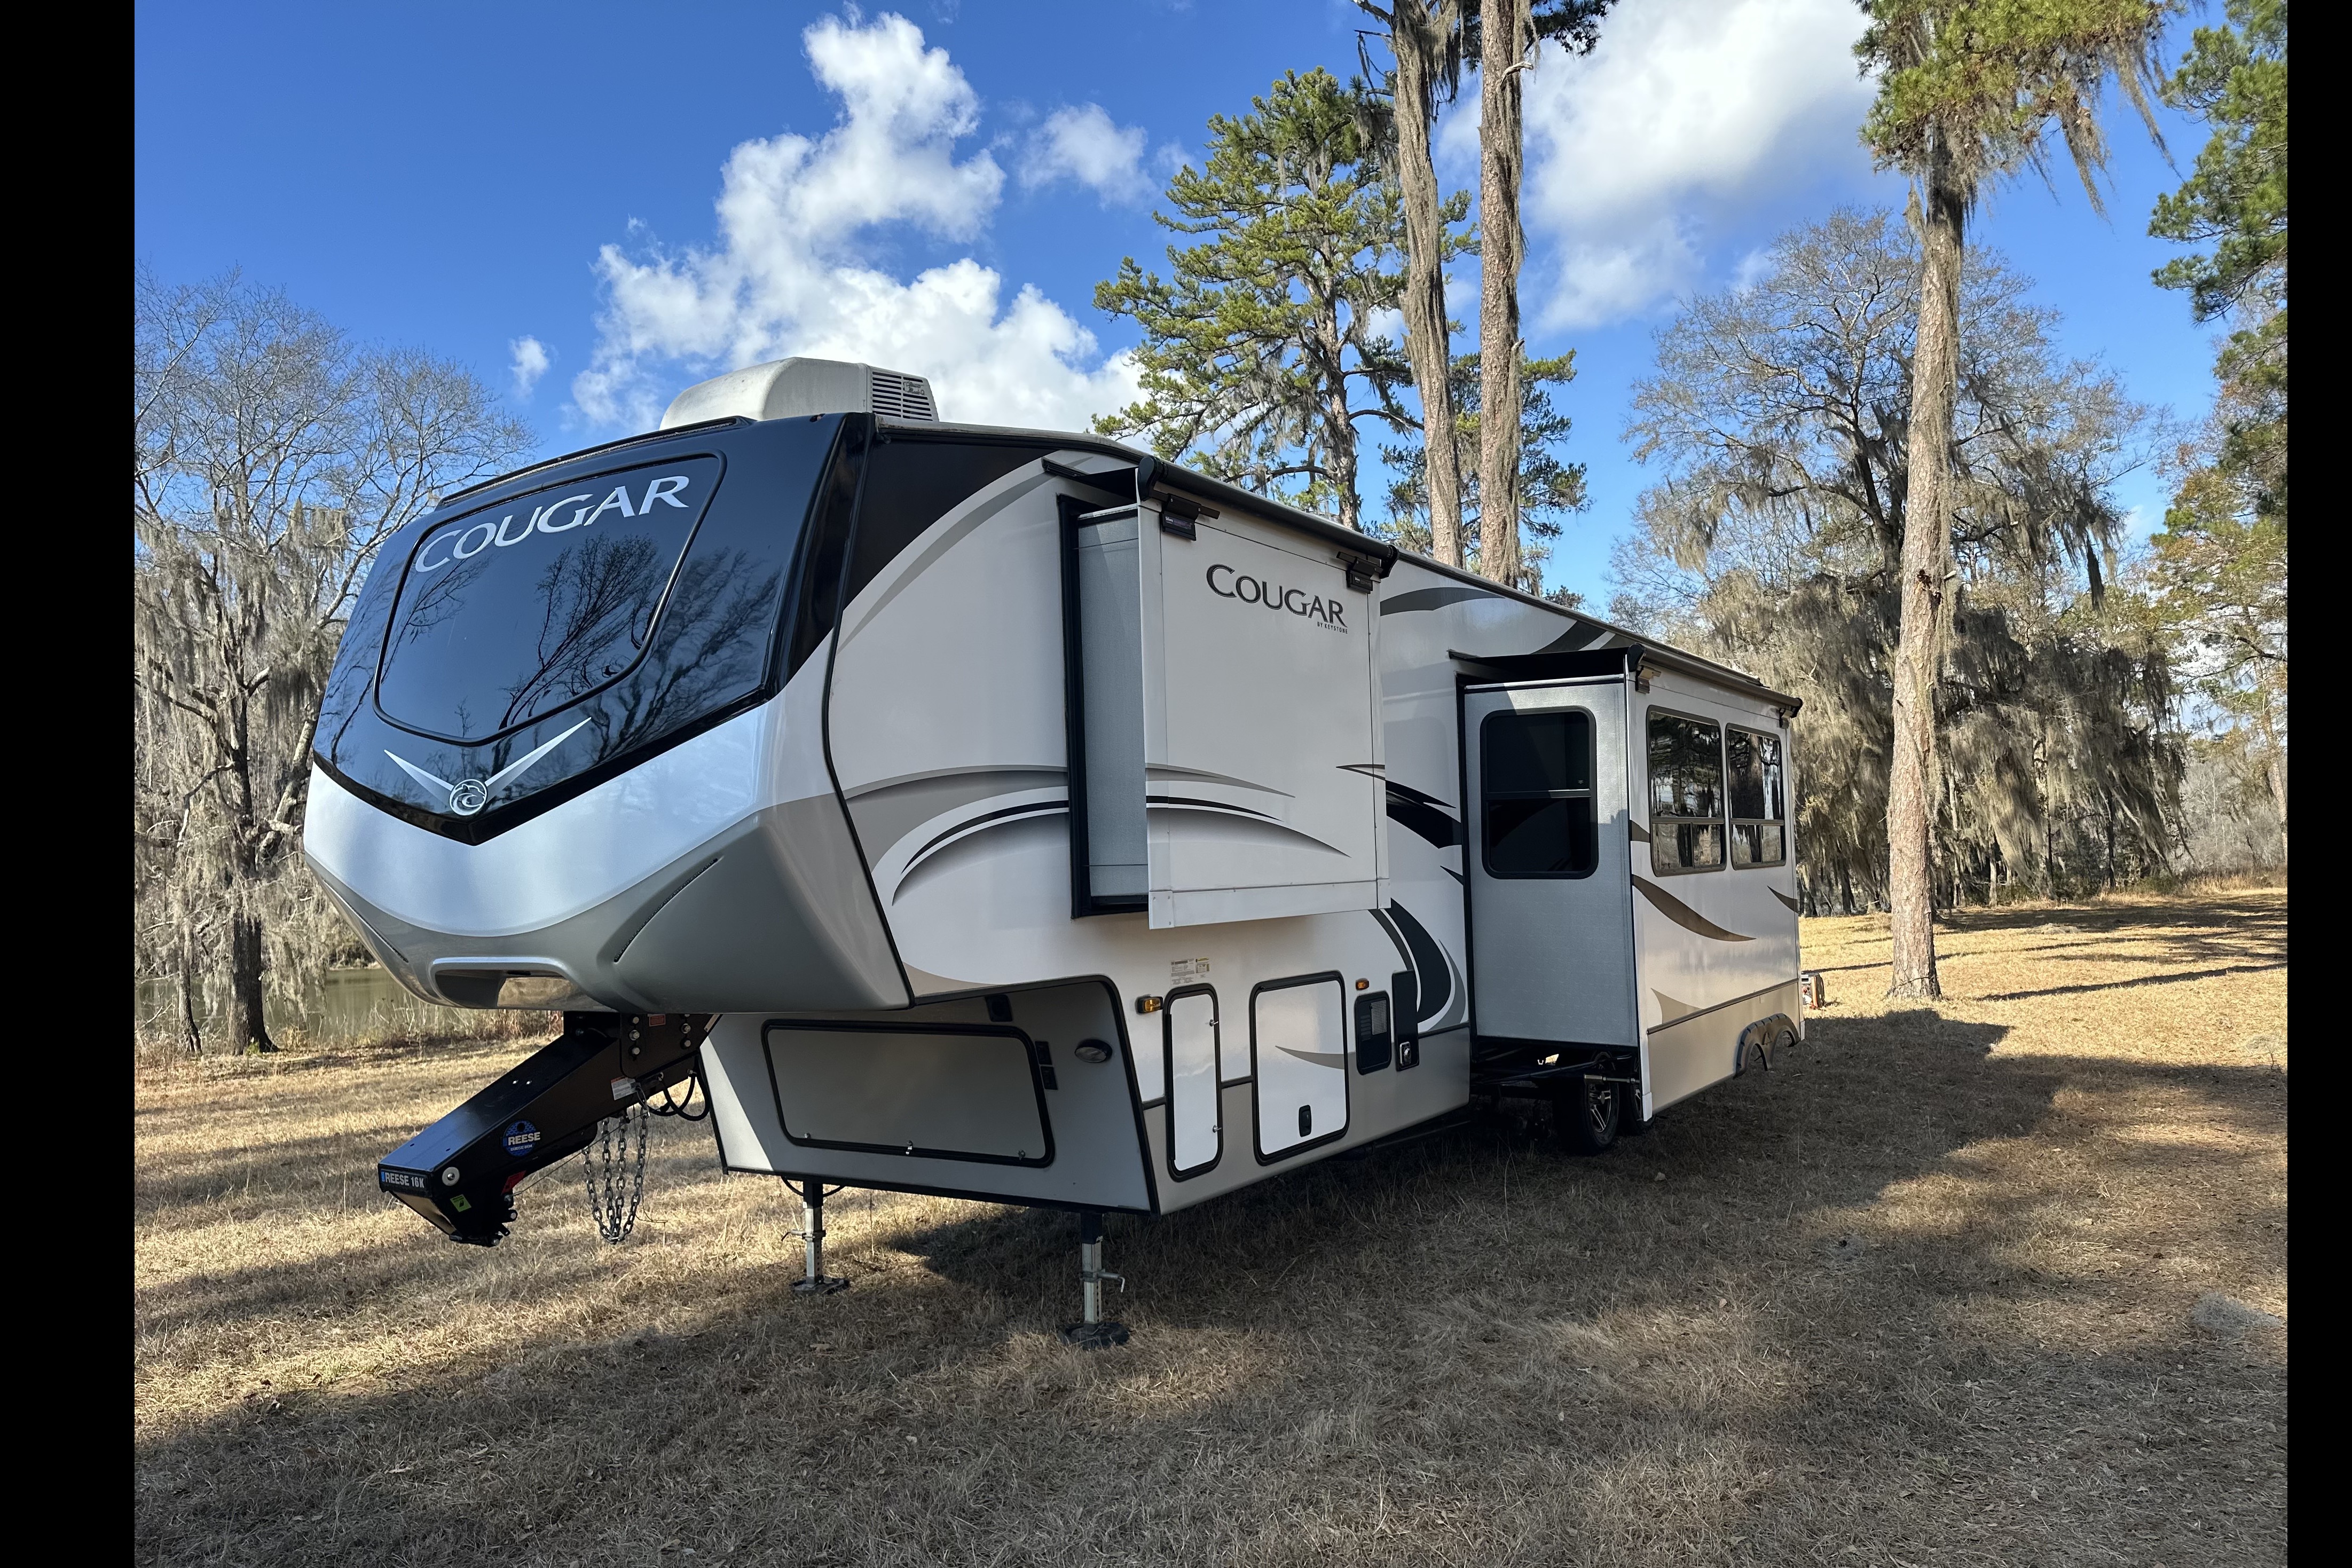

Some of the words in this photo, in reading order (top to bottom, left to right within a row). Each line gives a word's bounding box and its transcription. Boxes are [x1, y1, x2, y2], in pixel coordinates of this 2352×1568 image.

[415, 476, 689, 573] COUGAR
[1206, 563, 1348, 628] COUGAR
[508, 1131, 541, 1146] REESE
[384, 1172, 410, 1186] REESE
[411, 1176, 424, 1188] 16K
